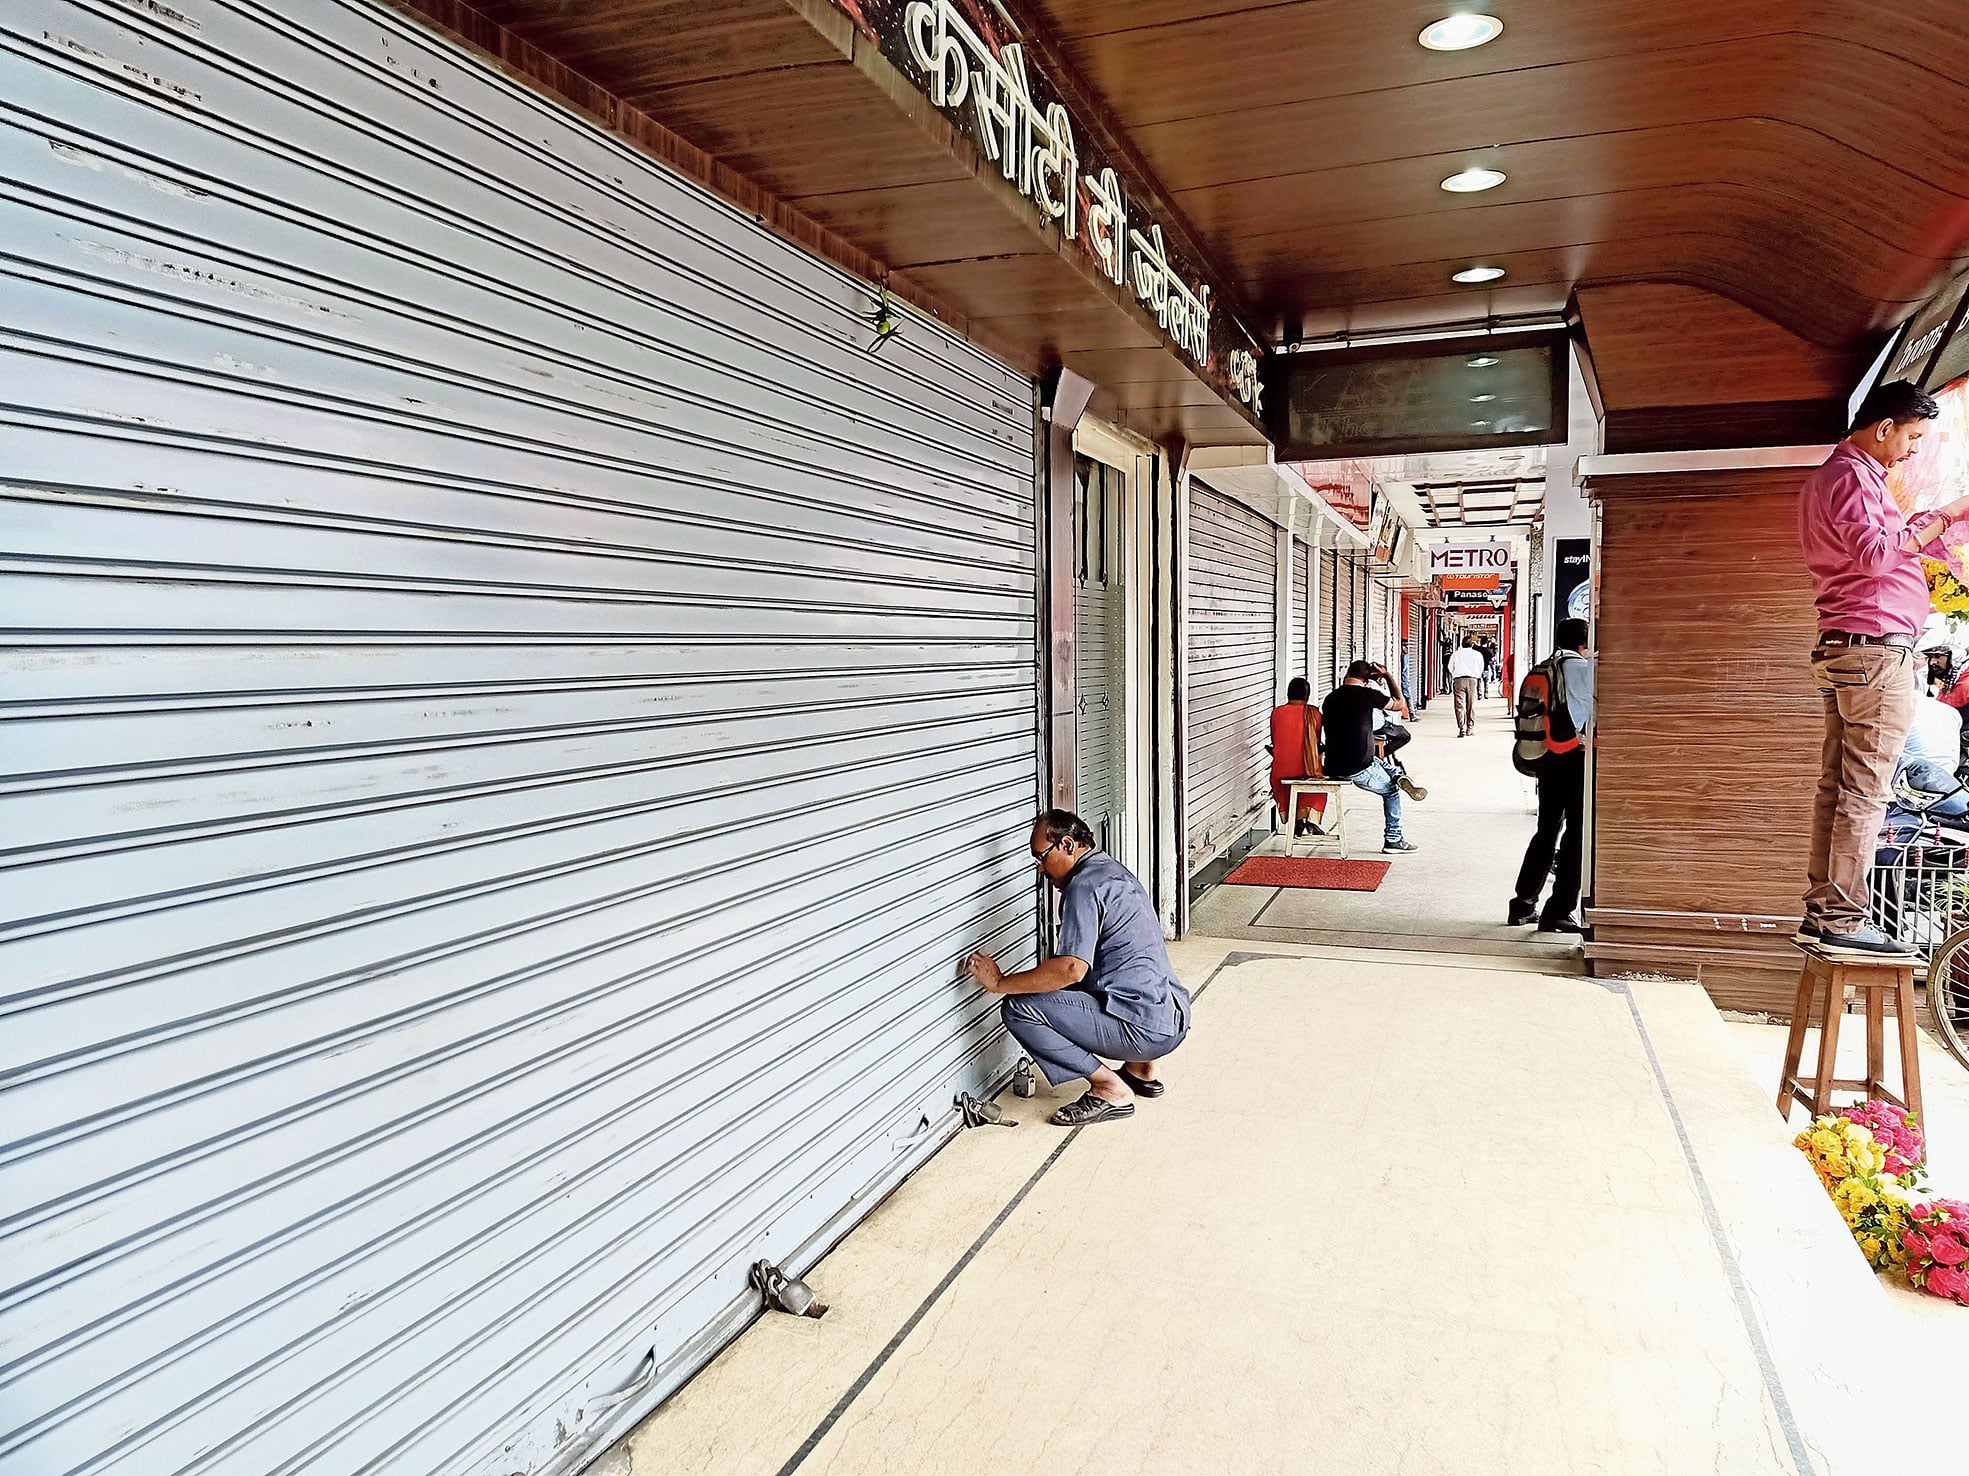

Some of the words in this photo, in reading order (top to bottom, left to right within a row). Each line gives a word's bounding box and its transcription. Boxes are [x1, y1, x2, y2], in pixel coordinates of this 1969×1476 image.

[905, 0, 1079, 240] कसौटी
[1085, 168, 1128, 285] दी
[1130, 224, 1211, 367] ज्वेलर्स
[1430, 548, 1508, 568] METRO
[1454, 590, 1488, 598] Panaso
